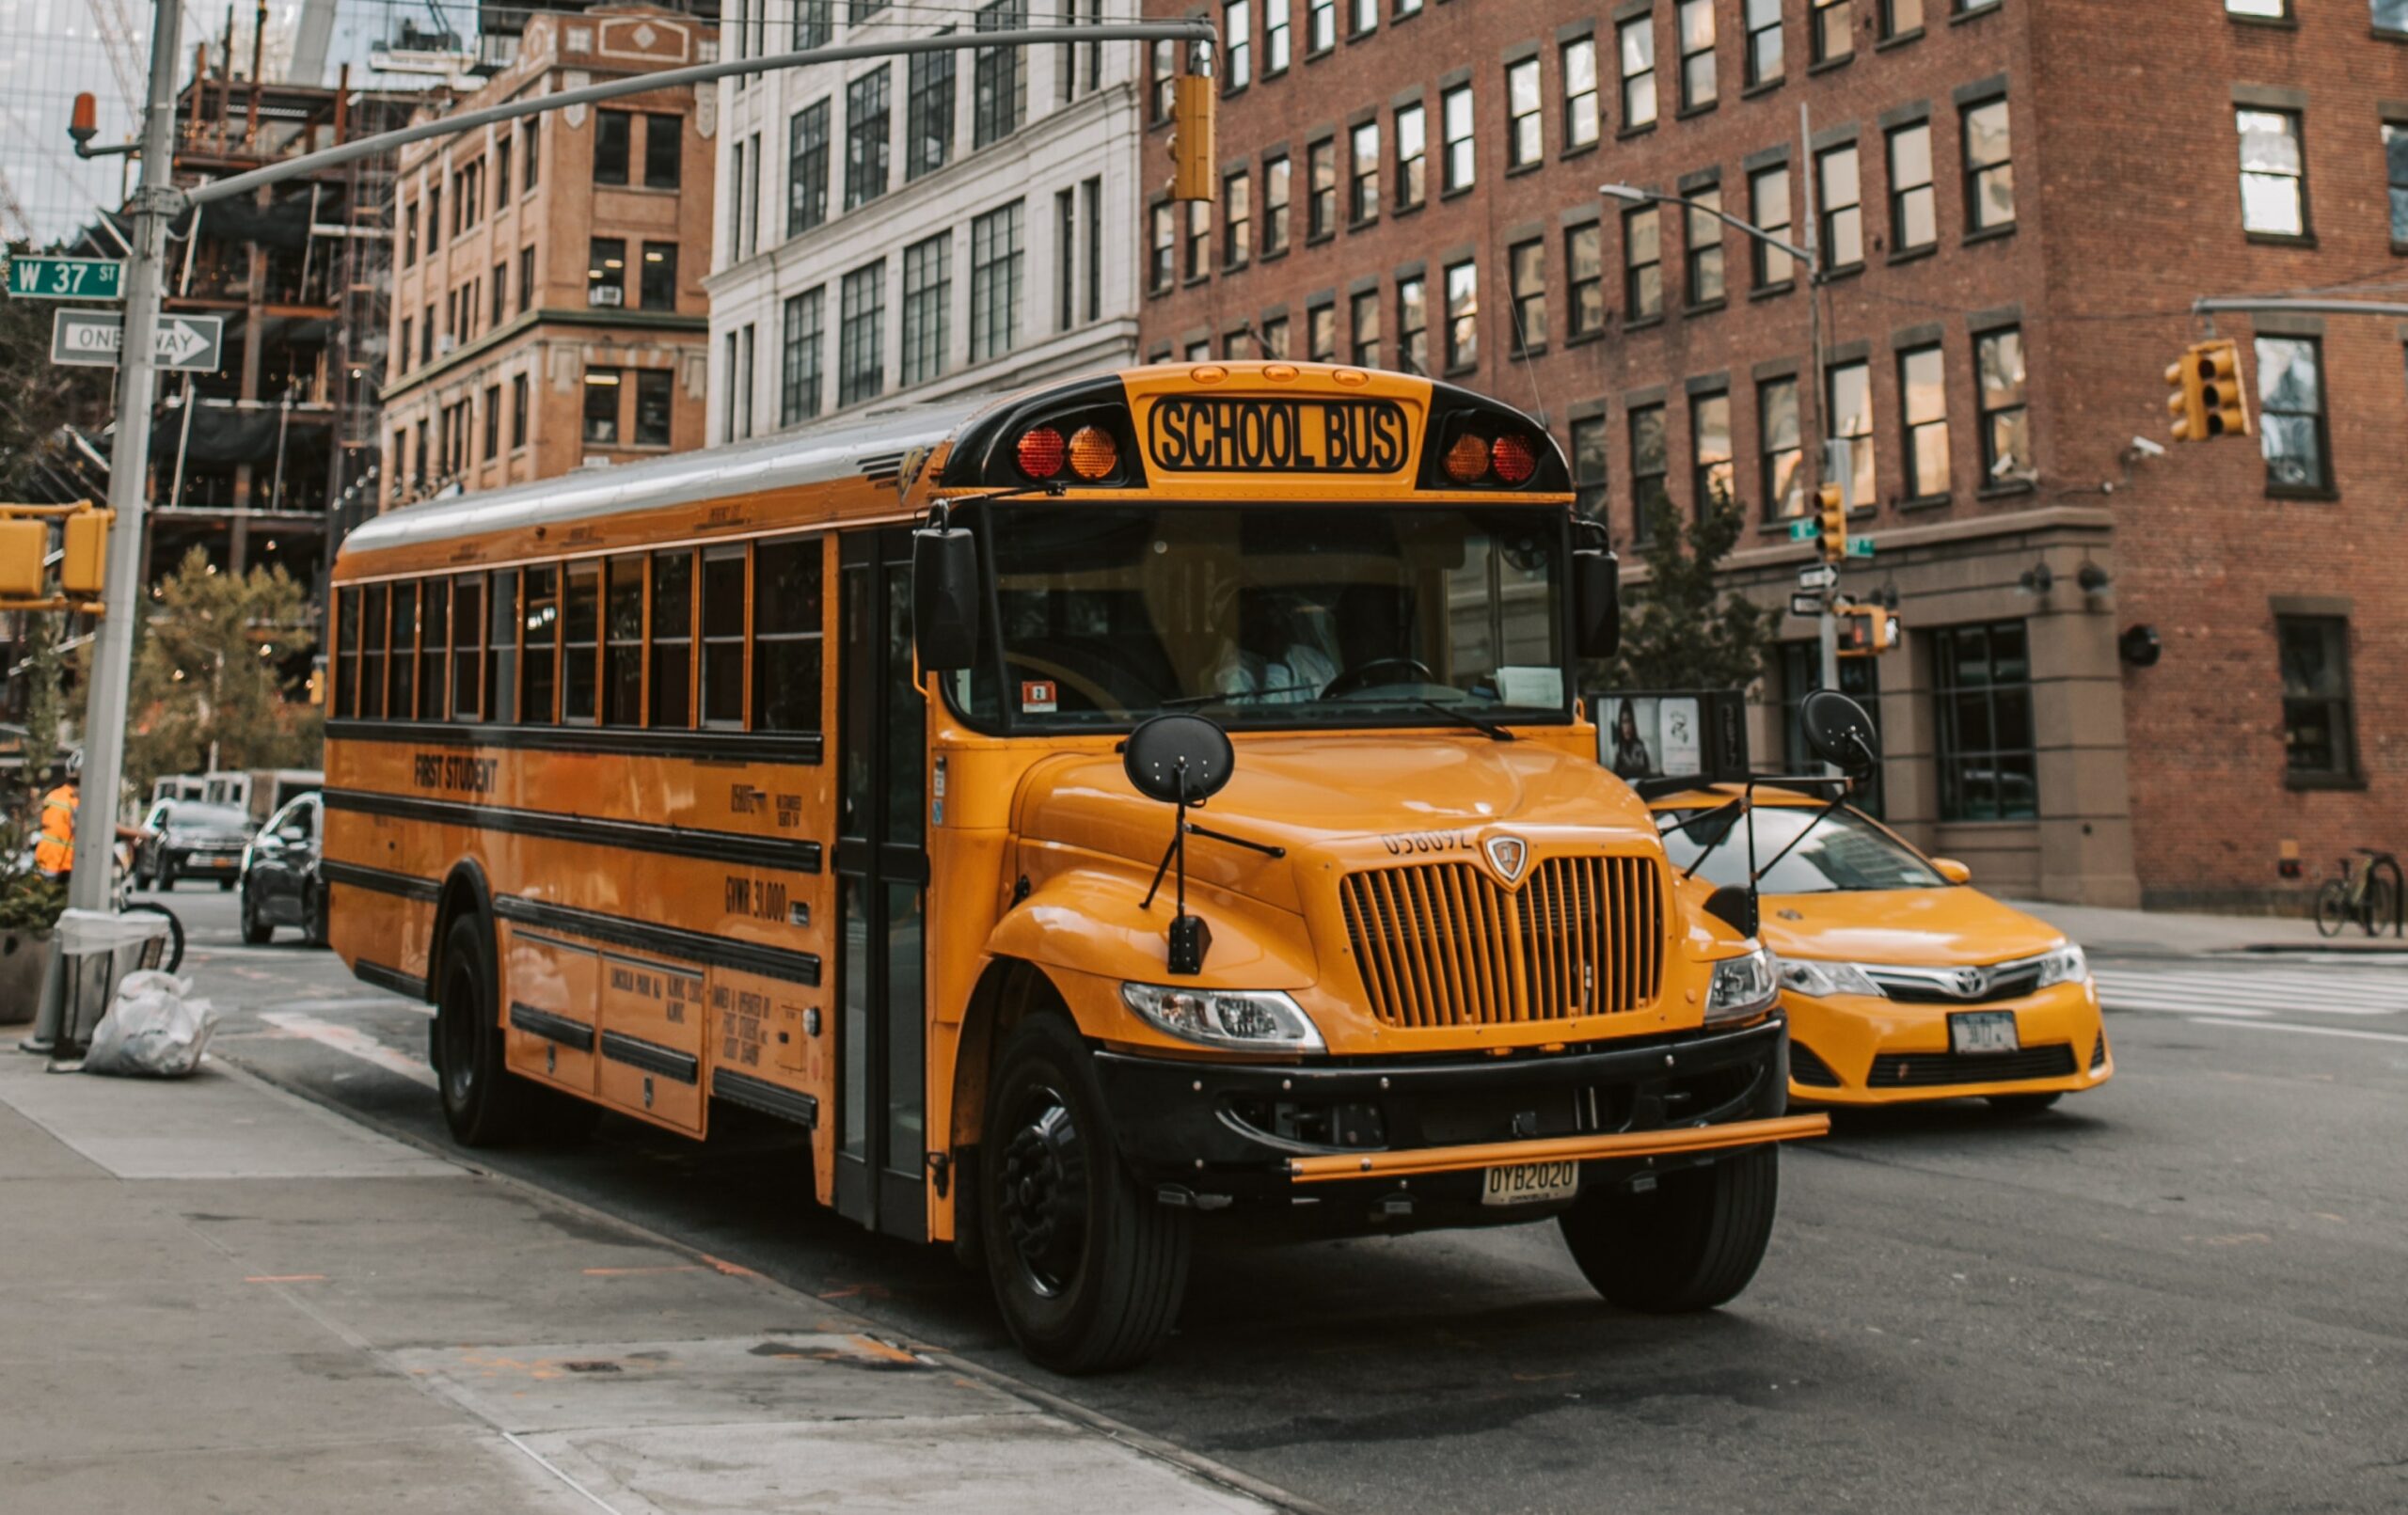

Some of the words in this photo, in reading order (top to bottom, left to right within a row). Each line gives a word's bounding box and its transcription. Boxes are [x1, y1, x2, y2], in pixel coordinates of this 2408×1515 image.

[19, 262, 40, 292] W
[53, 264, 88, 293] 37
[99, 265, 117, 281] ST
[79, 327, 123, 349] ONE
[1162, 402, 1315, 467] SCHOOL
[1324, 404, 1398, 469] BUS
[415, 753, 443, 788] FIRST
[446, 755, 498, 794] STUDENT
